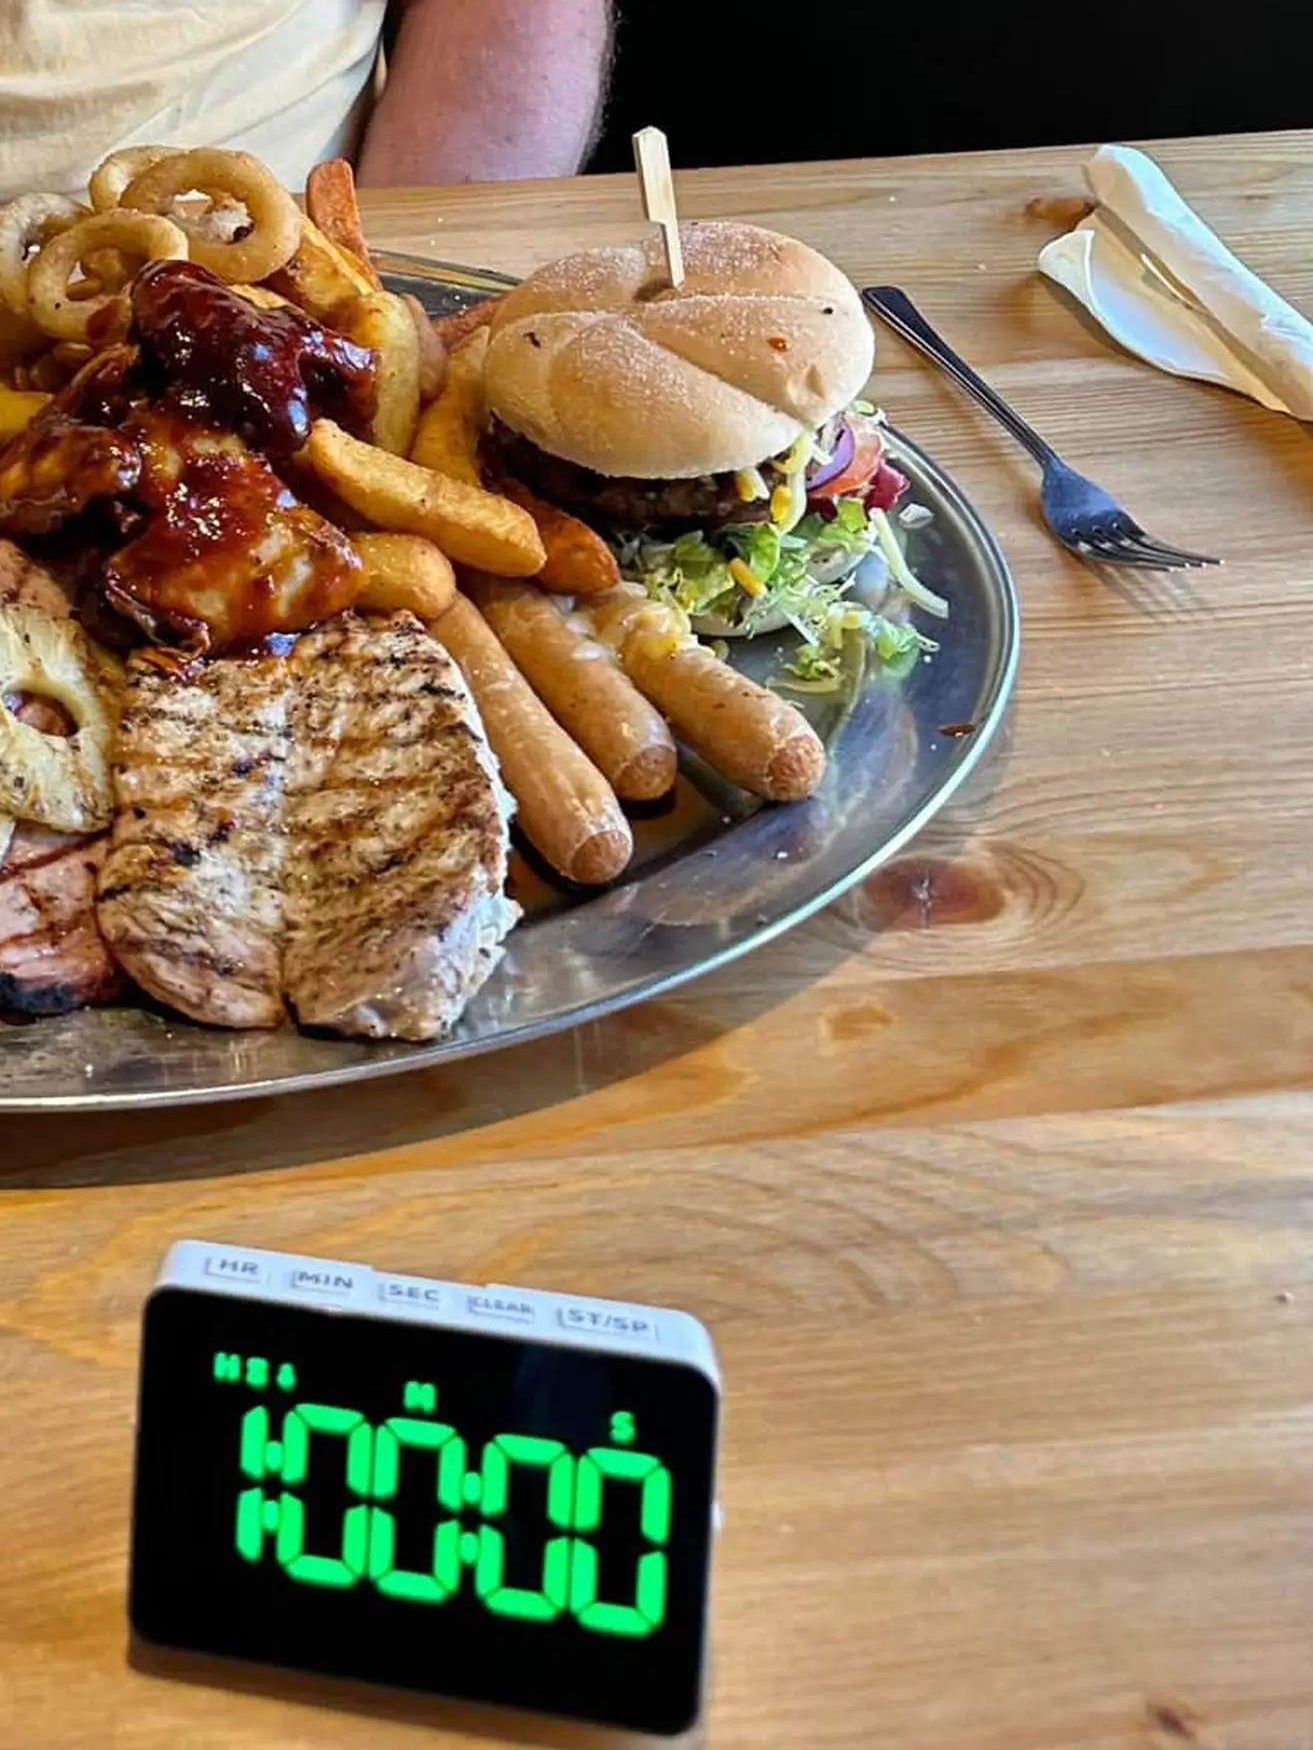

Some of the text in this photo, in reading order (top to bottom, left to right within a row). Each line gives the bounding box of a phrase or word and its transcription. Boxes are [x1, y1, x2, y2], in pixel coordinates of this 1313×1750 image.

[219, 1258, 649, 1332] HR MIN SEC CLEAR ST/SP
[610, 1410, 636, 1444] S
